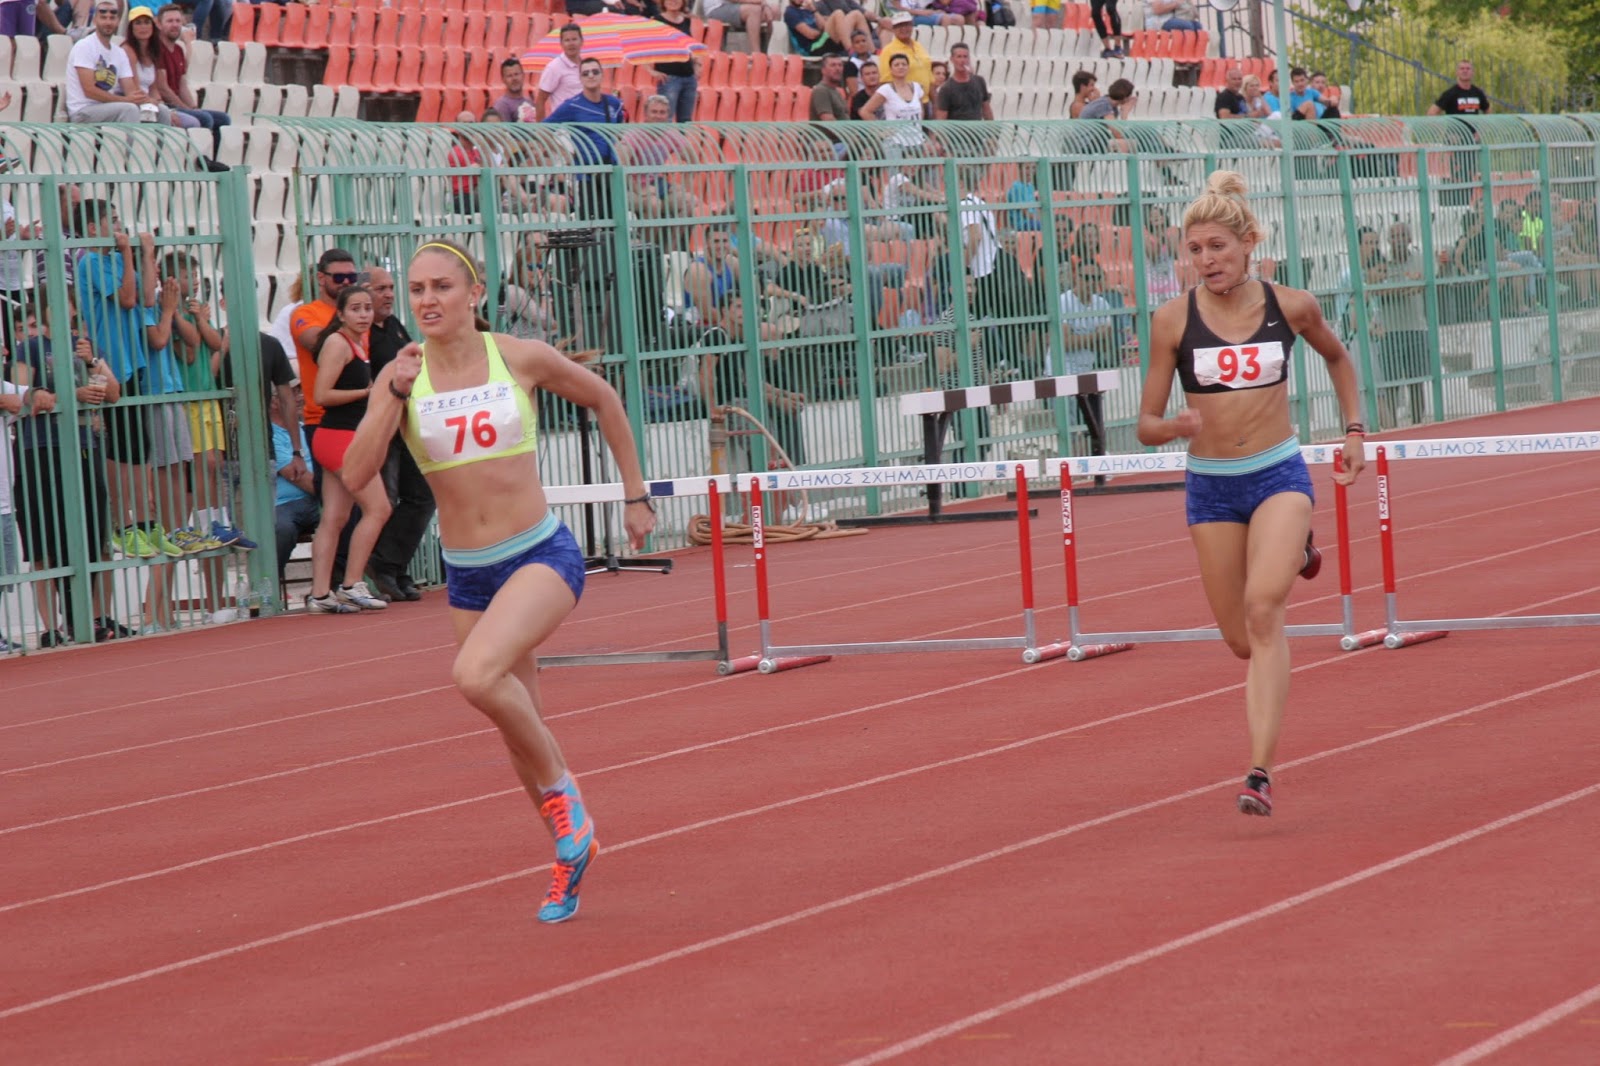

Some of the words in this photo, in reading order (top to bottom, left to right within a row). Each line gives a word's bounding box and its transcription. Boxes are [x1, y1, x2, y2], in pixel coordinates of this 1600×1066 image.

[1217, 346, 1261, 382] 93
[445, 410, 497, 454] 76
[1416, 441, 1486, 456] ΔΗΜΟΣ
[1098, 456, 1166, 471] ΔΗΜΟΣ
[787, 472, 853, 487] ΔΗΜΟΣ
[861, 465, 987, 484] ΣΧΗΜΑΤΑΡΙΟΥ
